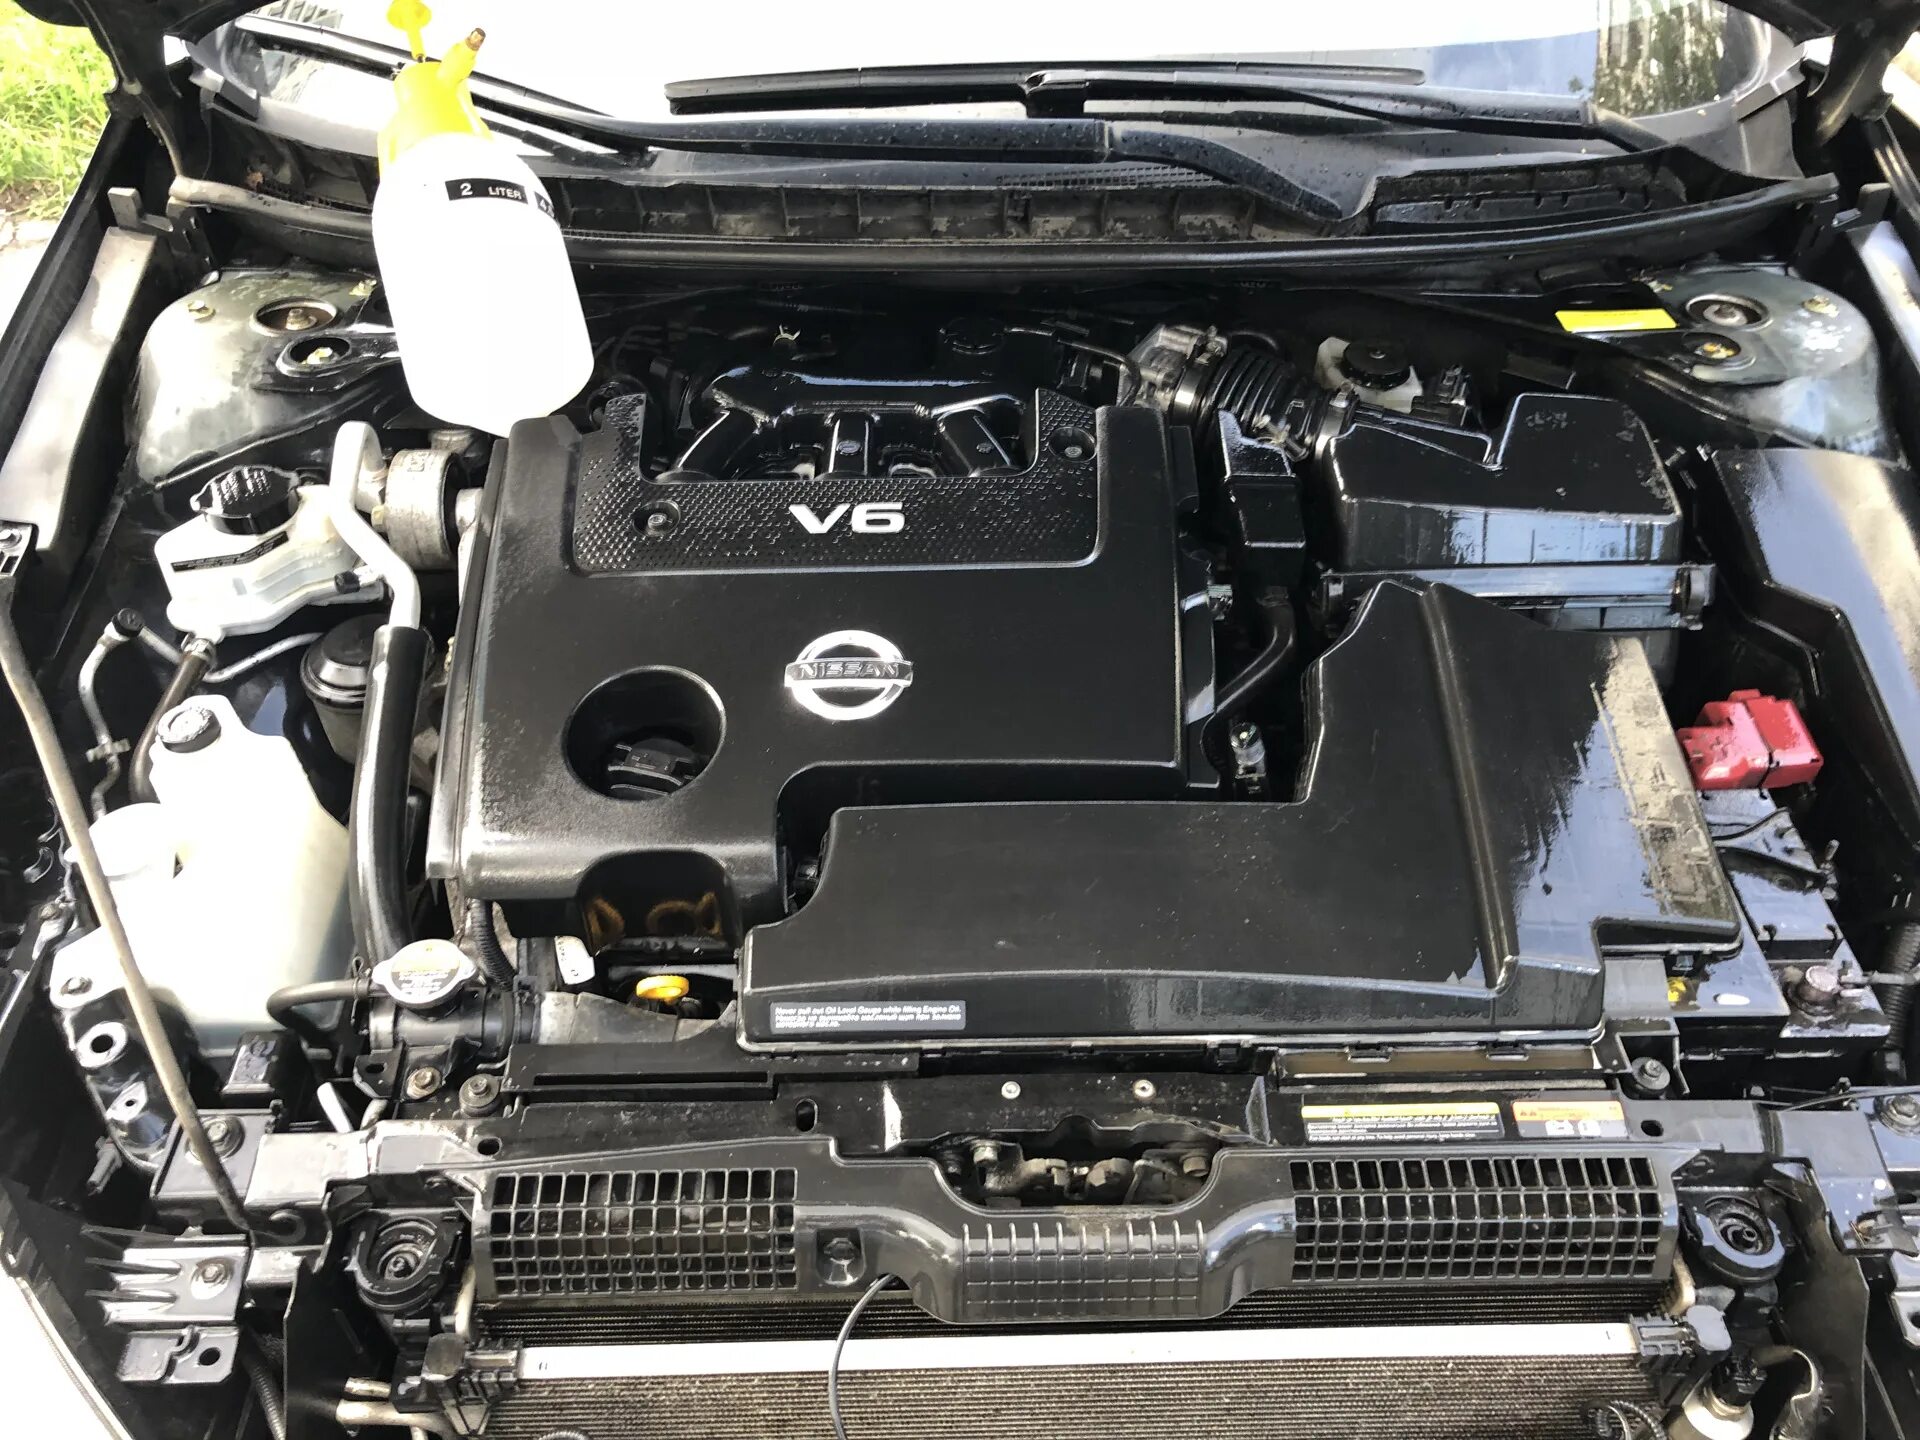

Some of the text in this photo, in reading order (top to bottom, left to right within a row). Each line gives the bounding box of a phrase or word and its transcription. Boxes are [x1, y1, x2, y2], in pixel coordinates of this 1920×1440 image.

[460, 182, 522, 200] 2 LITER
[788, 501, 906, 534] V6
[799, 660, 900, 680] NISSAN
[775, 1007, 797, 1015] Never
[825, 1006, 837, 1015] Oil
[838, 1006, 857, 1015] Level
[857, 1005, 882, 1016] Gauge
[883, 1005, 902, 1014] while
[922, 1004, 947, 1014] Engine
